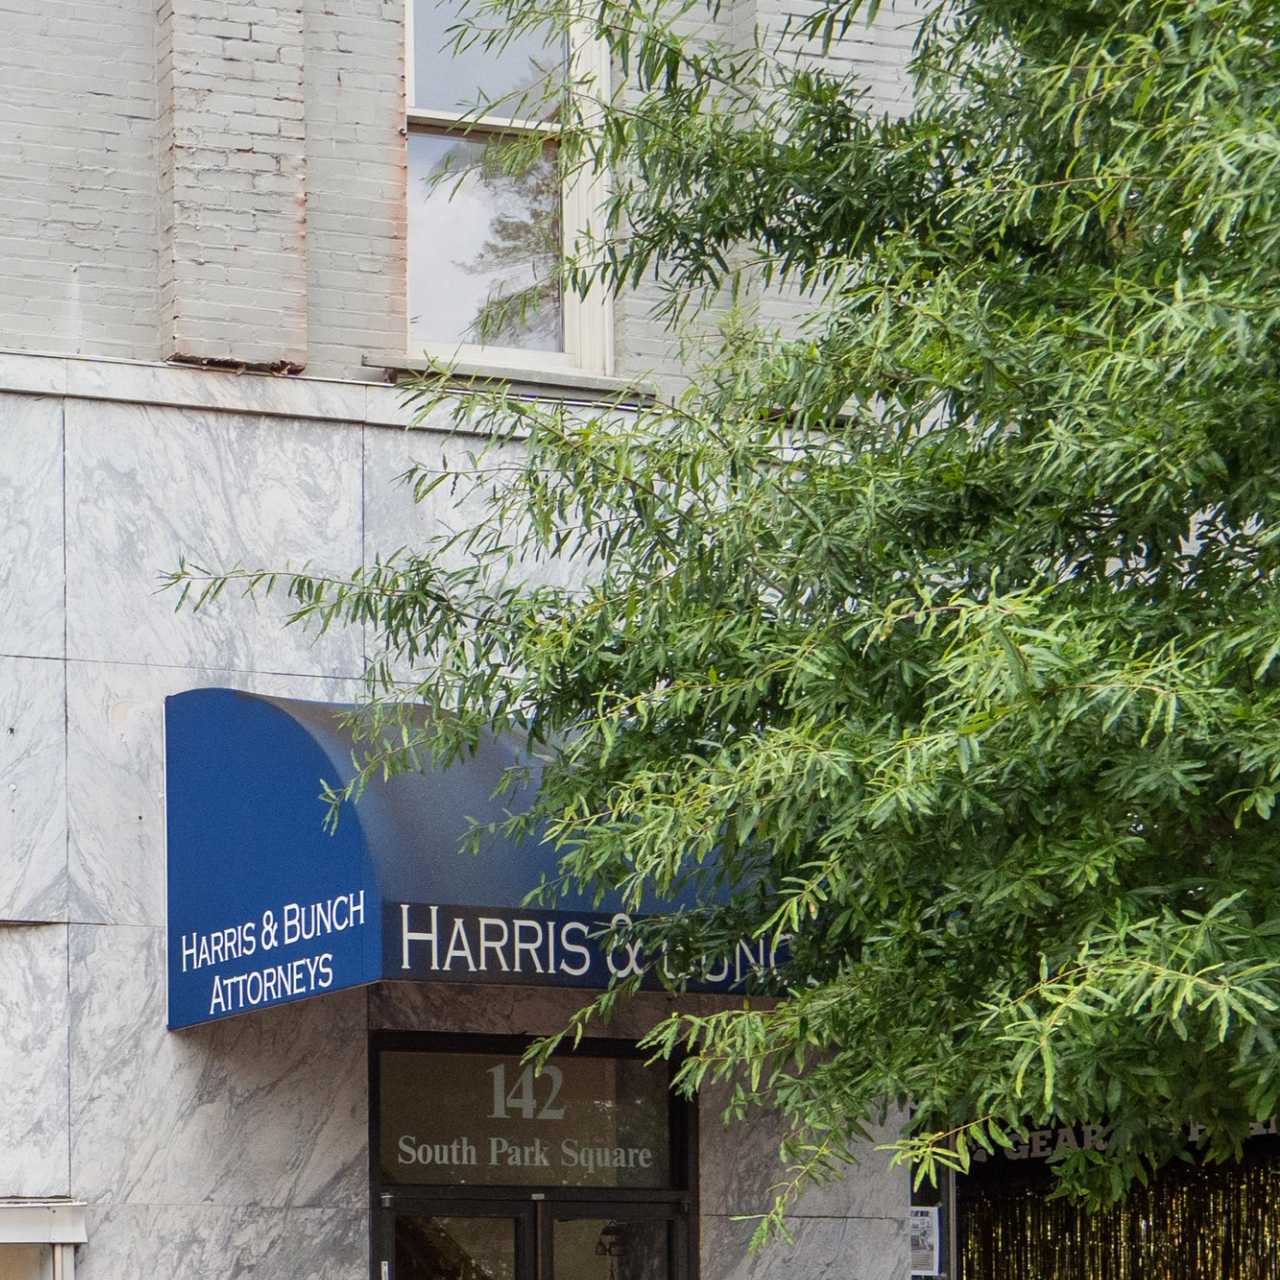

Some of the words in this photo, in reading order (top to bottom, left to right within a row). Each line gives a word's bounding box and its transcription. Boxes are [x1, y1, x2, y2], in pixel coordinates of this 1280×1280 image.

[182, 922, 257, 973] HARRIS
[261, 910, 279, 950] &
[283, 889, 365, 945] BUNCH
[400, 904, 592, 976] HARRIS
[606, 912, 644, 978] &
[209, 953, 334, 1015] ATTORNEYS
[486, 1063, 566, 1120] 142
[398, 1135, 477, 1167] South
[489, 1136, 549, 1168] Park
[561, 1138, 653, 1170] Square
